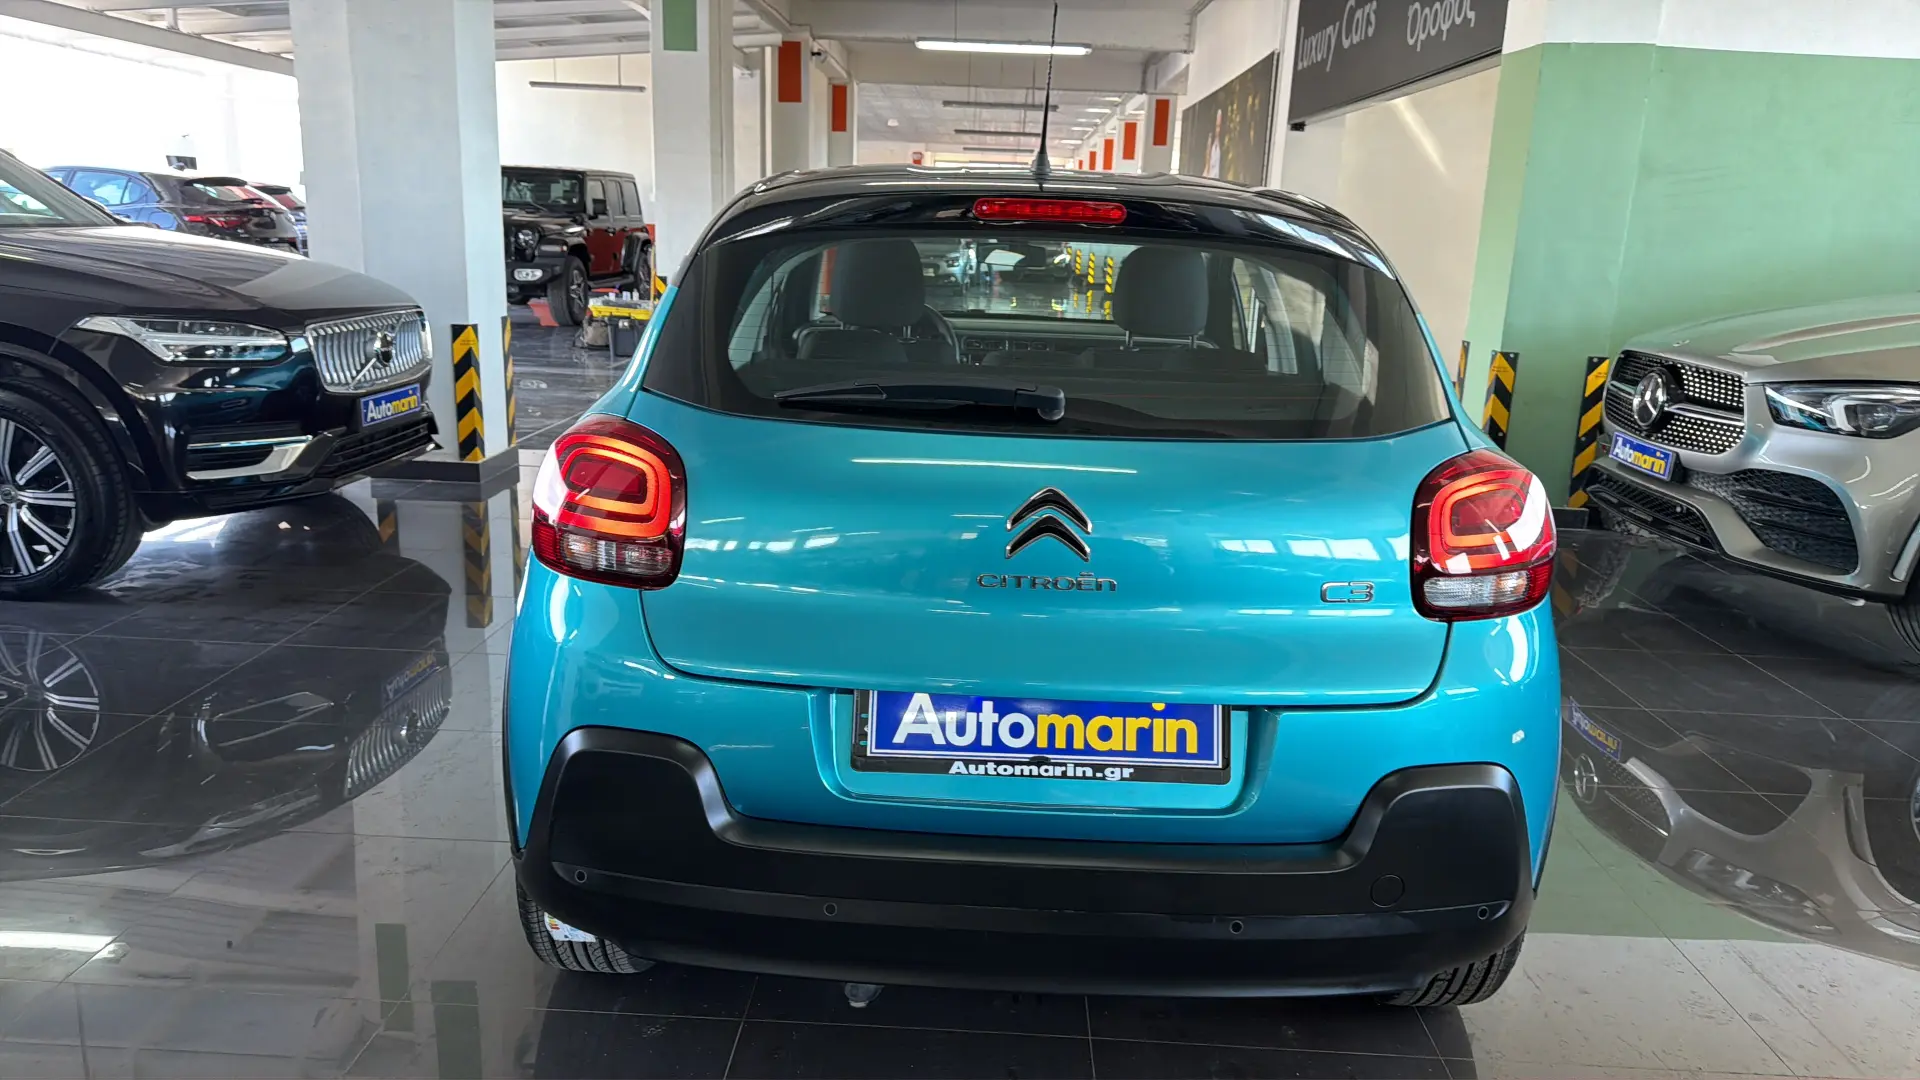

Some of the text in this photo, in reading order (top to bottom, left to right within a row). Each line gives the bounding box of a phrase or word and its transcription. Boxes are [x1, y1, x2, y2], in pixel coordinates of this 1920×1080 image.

[1298, 0, 1377, 71] Luxury Cars
[1320, 581, 1375, 603] C3
[892, 692, 1198, 754] Automarin
[949, 760, 1135, 781] Automarin.gr
